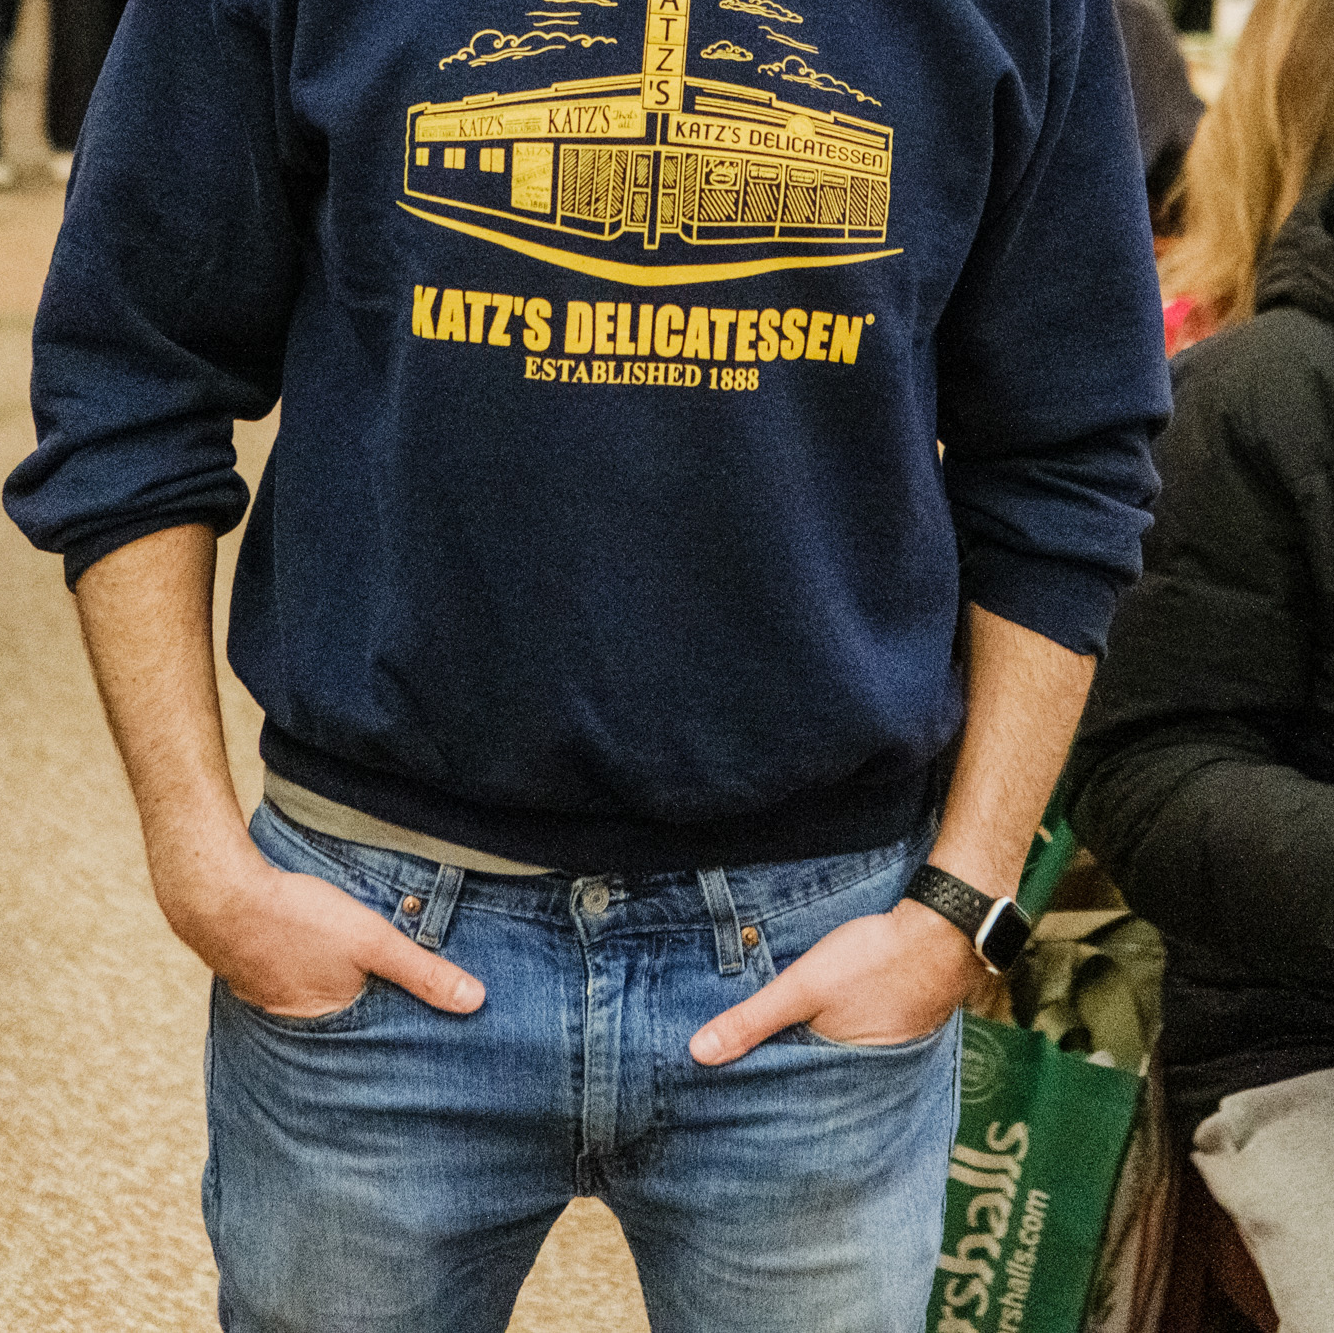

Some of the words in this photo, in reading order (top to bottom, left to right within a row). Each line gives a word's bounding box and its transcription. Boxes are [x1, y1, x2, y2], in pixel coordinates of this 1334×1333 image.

[458, 115, 504, 138] KATZ'S
[547, 104, 611, 135] KATZ'S
[675, 120, 741, 144] KATZ'S
[748, 129, 884, 169] DELICATESSEN
[411, 284, 552, 352] KATZ'S
[564, 300, 863, 365] DELICATESSEN
[523, 356, 702, 388] ESTABLISHED
[708, 366, 760, 391] 1888
[997, 1188, 1051, 1333] rshalls.com
